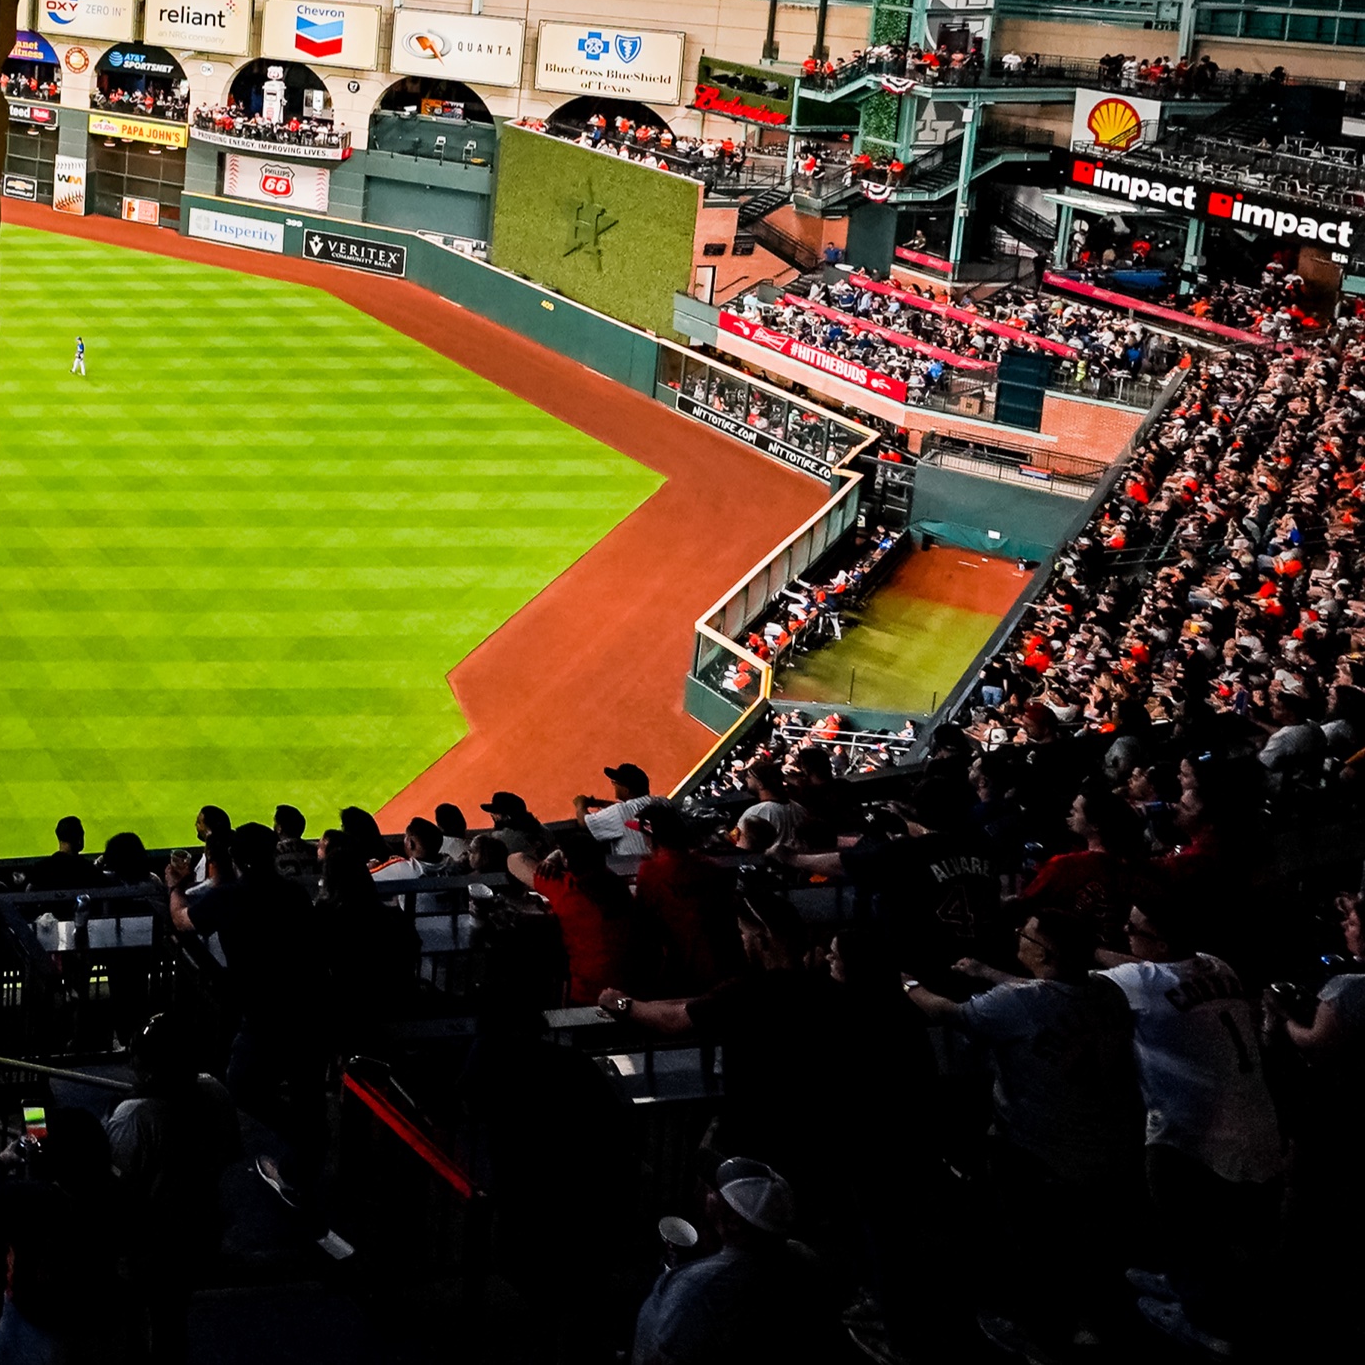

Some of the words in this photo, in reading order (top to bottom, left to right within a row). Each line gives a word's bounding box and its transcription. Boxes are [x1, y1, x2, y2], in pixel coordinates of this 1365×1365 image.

[46, 0, 78, 12] OXY
[86, 4, 110, 15] ZERO
[159, 6, 226, 28] reliant
[296, 4, 345, 18] Chevron
[457, 41, 513, 57] QUANTA
[123, 60, 174, 74] SPORTSNET
[545, 63, 604, 79] BlueCross
[606, 69, 672, 85] BlueShield
[580, 79, 593, 89] of
[596, 81, 632, 94] Texas
[121, 124, 144, 137] PAPA
[146, 128, 181, 143] JOHN'S
[198, 131, 227, 145] PROVIDING
[228, 138, 256, 149] ENERGY.
[258, 142, 302, 155] IMPROVING
[303, 148, 330, 157] LIVES.
[57, 173, 83, 185] WM
[264, 167, 290, 178] PHILLIPS
[265, 178, 288, 192] 66
[1093, 161, 1197, 211] impact
[1232, 193, 1354, 248] impact
[213, 219, 277, 245] Insperity
[331, 252, 373, 264] COMMUNITY
[789, 343, 868, 385] #HITTHEBUDS
[692, 405, 758, 443] NITTOTIRE.COM
[768, 441, 832, 476] NITTOTIRE.CO
[929, 854, 998, 883] ALVARE
